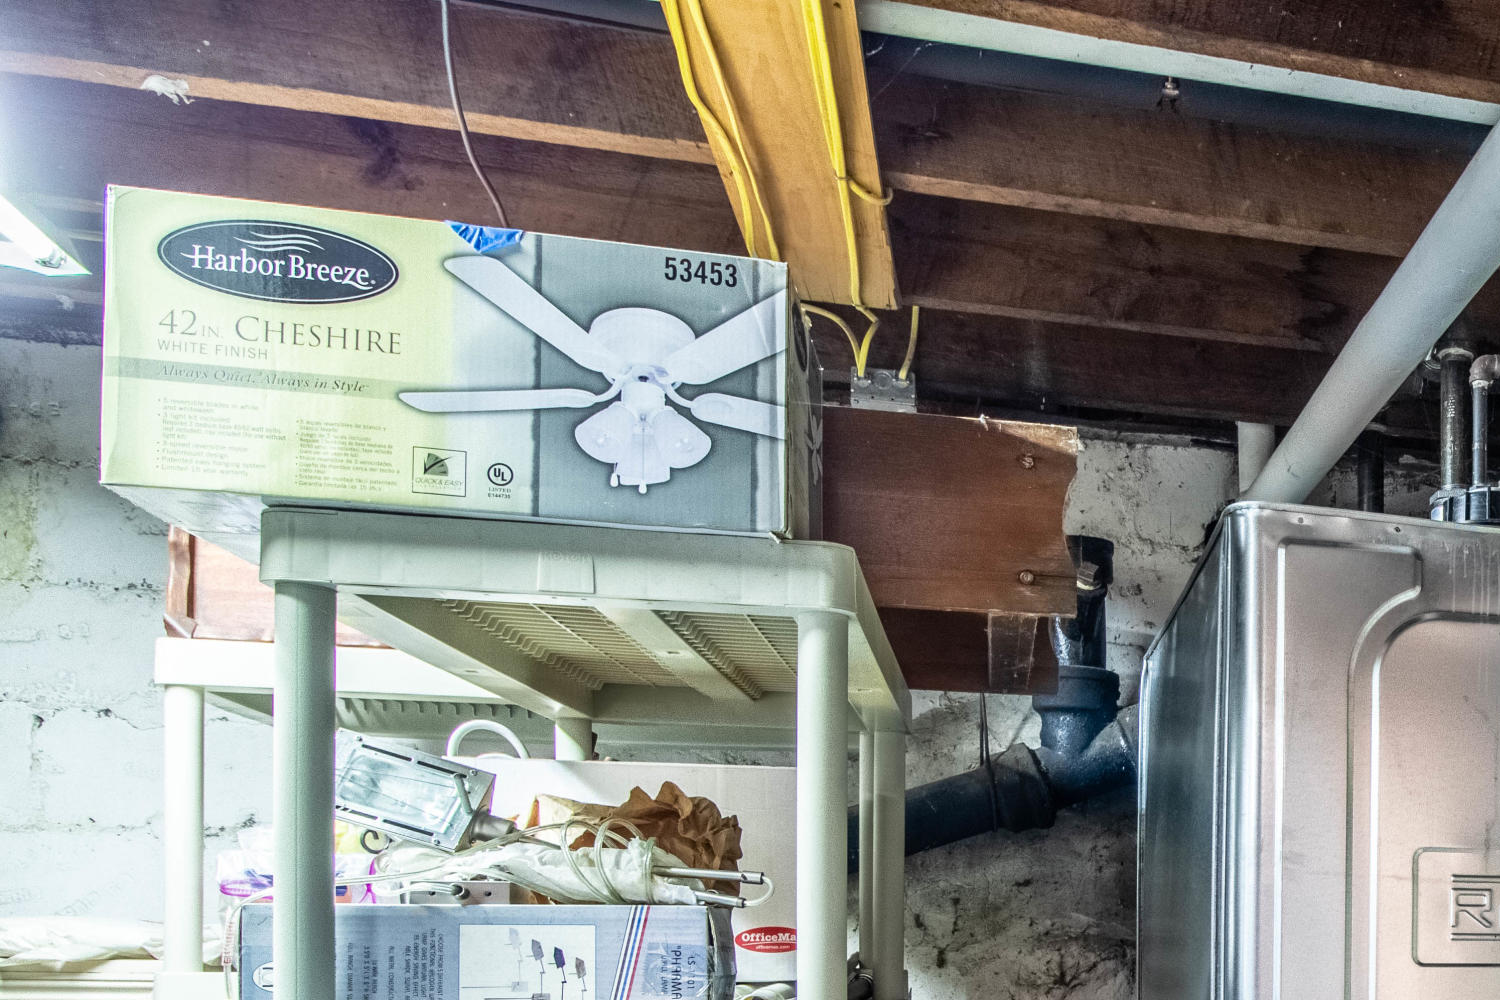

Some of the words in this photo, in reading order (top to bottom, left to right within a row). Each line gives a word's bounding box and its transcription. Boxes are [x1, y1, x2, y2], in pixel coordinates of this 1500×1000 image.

[180, 244, 286, 277] Harbor
[288, 254, 374, 290] Breeze
[664, 256, 738, 288] 53453
[158, 309, 198, 336] 42
[235, 315, 402, 355] CHESHIRE
[156, 338, 209, 355] WHITE
[215, 343, 269, 360] FINISH
[158, 364, 209, 380] Always
[262, 373, 311, 388] Always
[313, 377, 328, 390] in
[332, 379, 370, 393] Style
[493, 468, 507, 481] UL
[741, 932, 797, 942] OfficeMa
